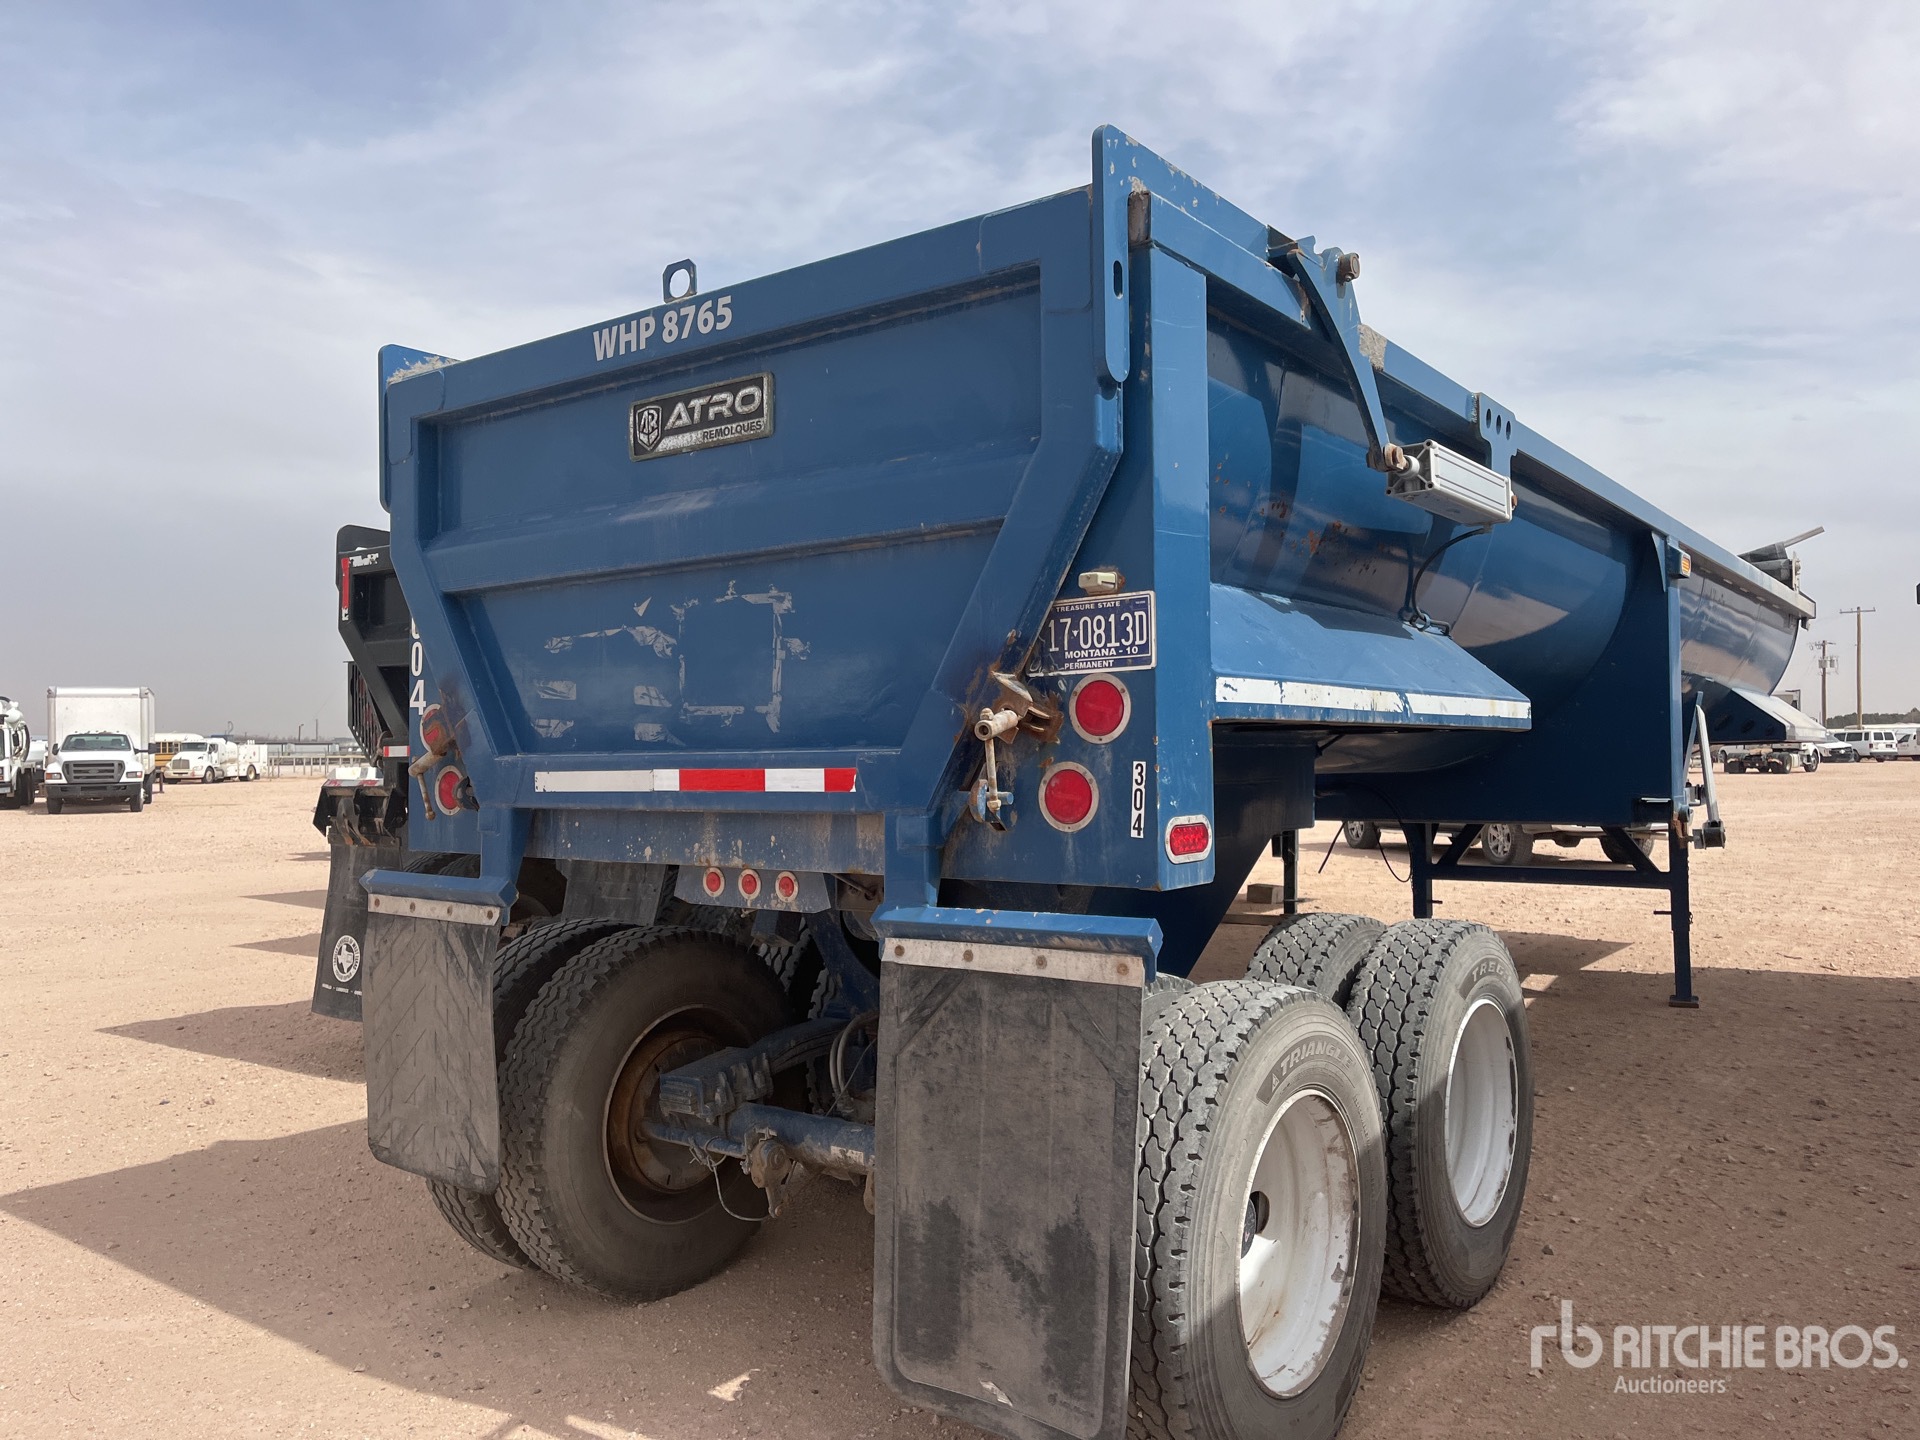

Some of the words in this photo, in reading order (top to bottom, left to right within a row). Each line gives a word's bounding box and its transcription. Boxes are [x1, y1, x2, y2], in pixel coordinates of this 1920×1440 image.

[593, 316, 656, 362] WHP
[662, 295, 733, 344] 8765
[664, 385, 762, 431] ATRO
[703, 420, 763, 440] REMOLQUES
[1056, 602, 1095, 612] TREASURE
[1097, 601, 1121, 609] STATE
[1064, 648, 1117, 659] MONTANA
[1125, 646, 1138, 655] 10
[1064, 659, 1114, 670] PERMANENT
[1132, 762, 1144, 837] 304
[1280, 1040, 1355, 1077] TRIANGLE
